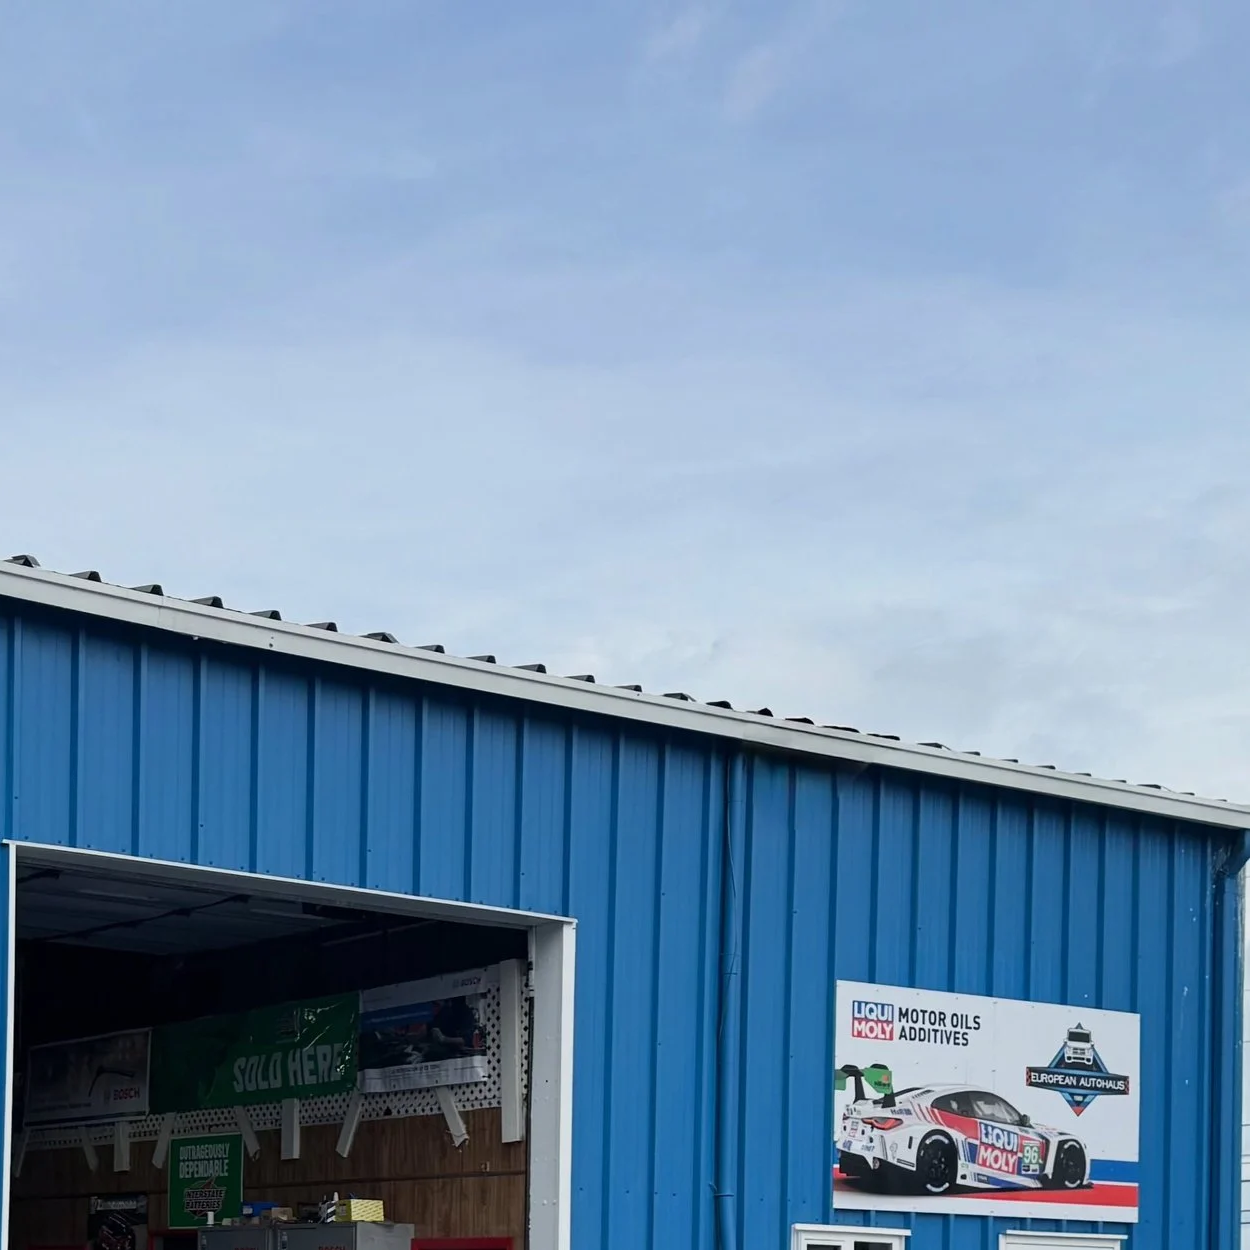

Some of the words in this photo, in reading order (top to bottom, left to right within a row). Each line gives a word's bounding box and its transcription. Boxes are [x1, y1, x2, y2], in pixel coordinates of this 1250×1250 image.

[854, 1001, 894, 1021] LIQUI
[899, 1007, 947, 1028] MOTOR
[951, 1013, 981, 1031] OILS
[853, 1020, 893, 1039] MOLY
[899, 1026, 969, 1046] ADDITIVES
[233, 1052, 283, 1093] SOLD
[288, 1042, 348, 1087] HERE
[1031, 1072, 1077, 1086] EUROPEAN
[1079, 1077, 1126, 1090] AUTOHAUS
[113, 1087, 140, 1101] BOSCH
[980, 1123, 1018, 1152] LIQUI
[179, 1143, 230, 1160] OUTRAGEOUSLY
[978, 1145, 1017, 1173] MOLY
[1024, 1146, 1039, 1164] 96
[179, 1160, 229, 1179] DEPENDABLE
[186, 1189, 225, 1199] INTERSTATE
